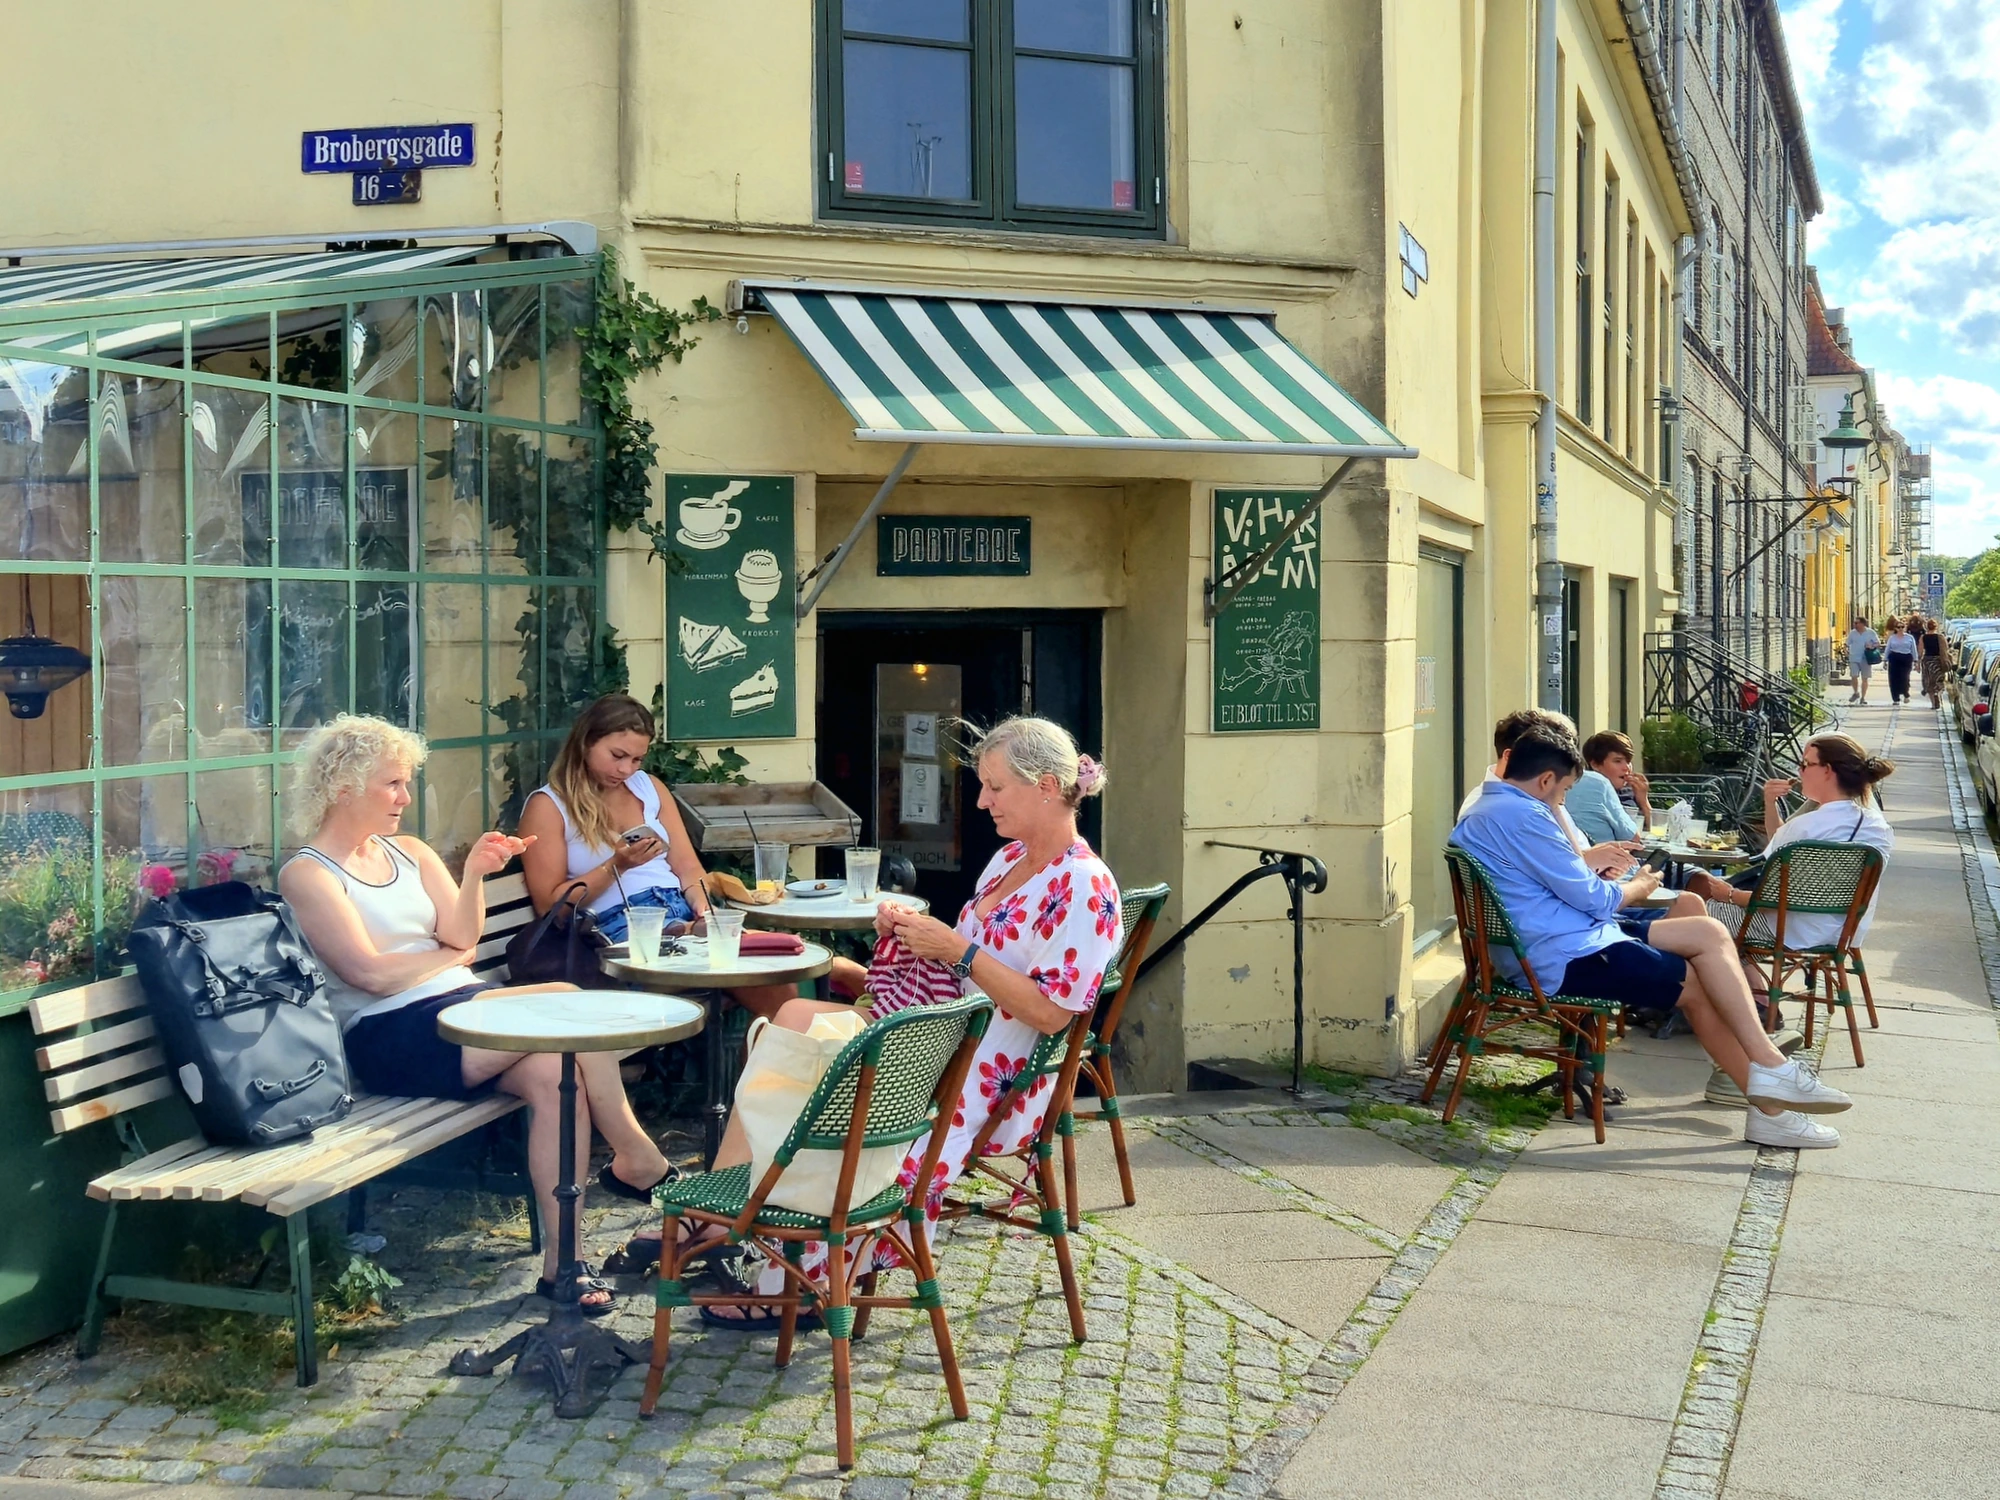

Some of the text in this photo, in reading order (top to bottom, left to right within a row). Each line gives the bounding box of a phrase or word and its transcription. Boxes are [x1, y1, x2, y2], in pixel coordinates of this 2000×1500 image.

[314, 129, 462, 165] Brobergsgade
[360, 175, 380, 201] 16
[893, 527, 1021, 562] PARTERRE
[1931, 573, 1941, 585] P
[742, 629, 779, 637] FROKOST
[684, 699, 706, 707] KAGE
[1221, 703, 1317, 724] EI BLOT TIL LYST
